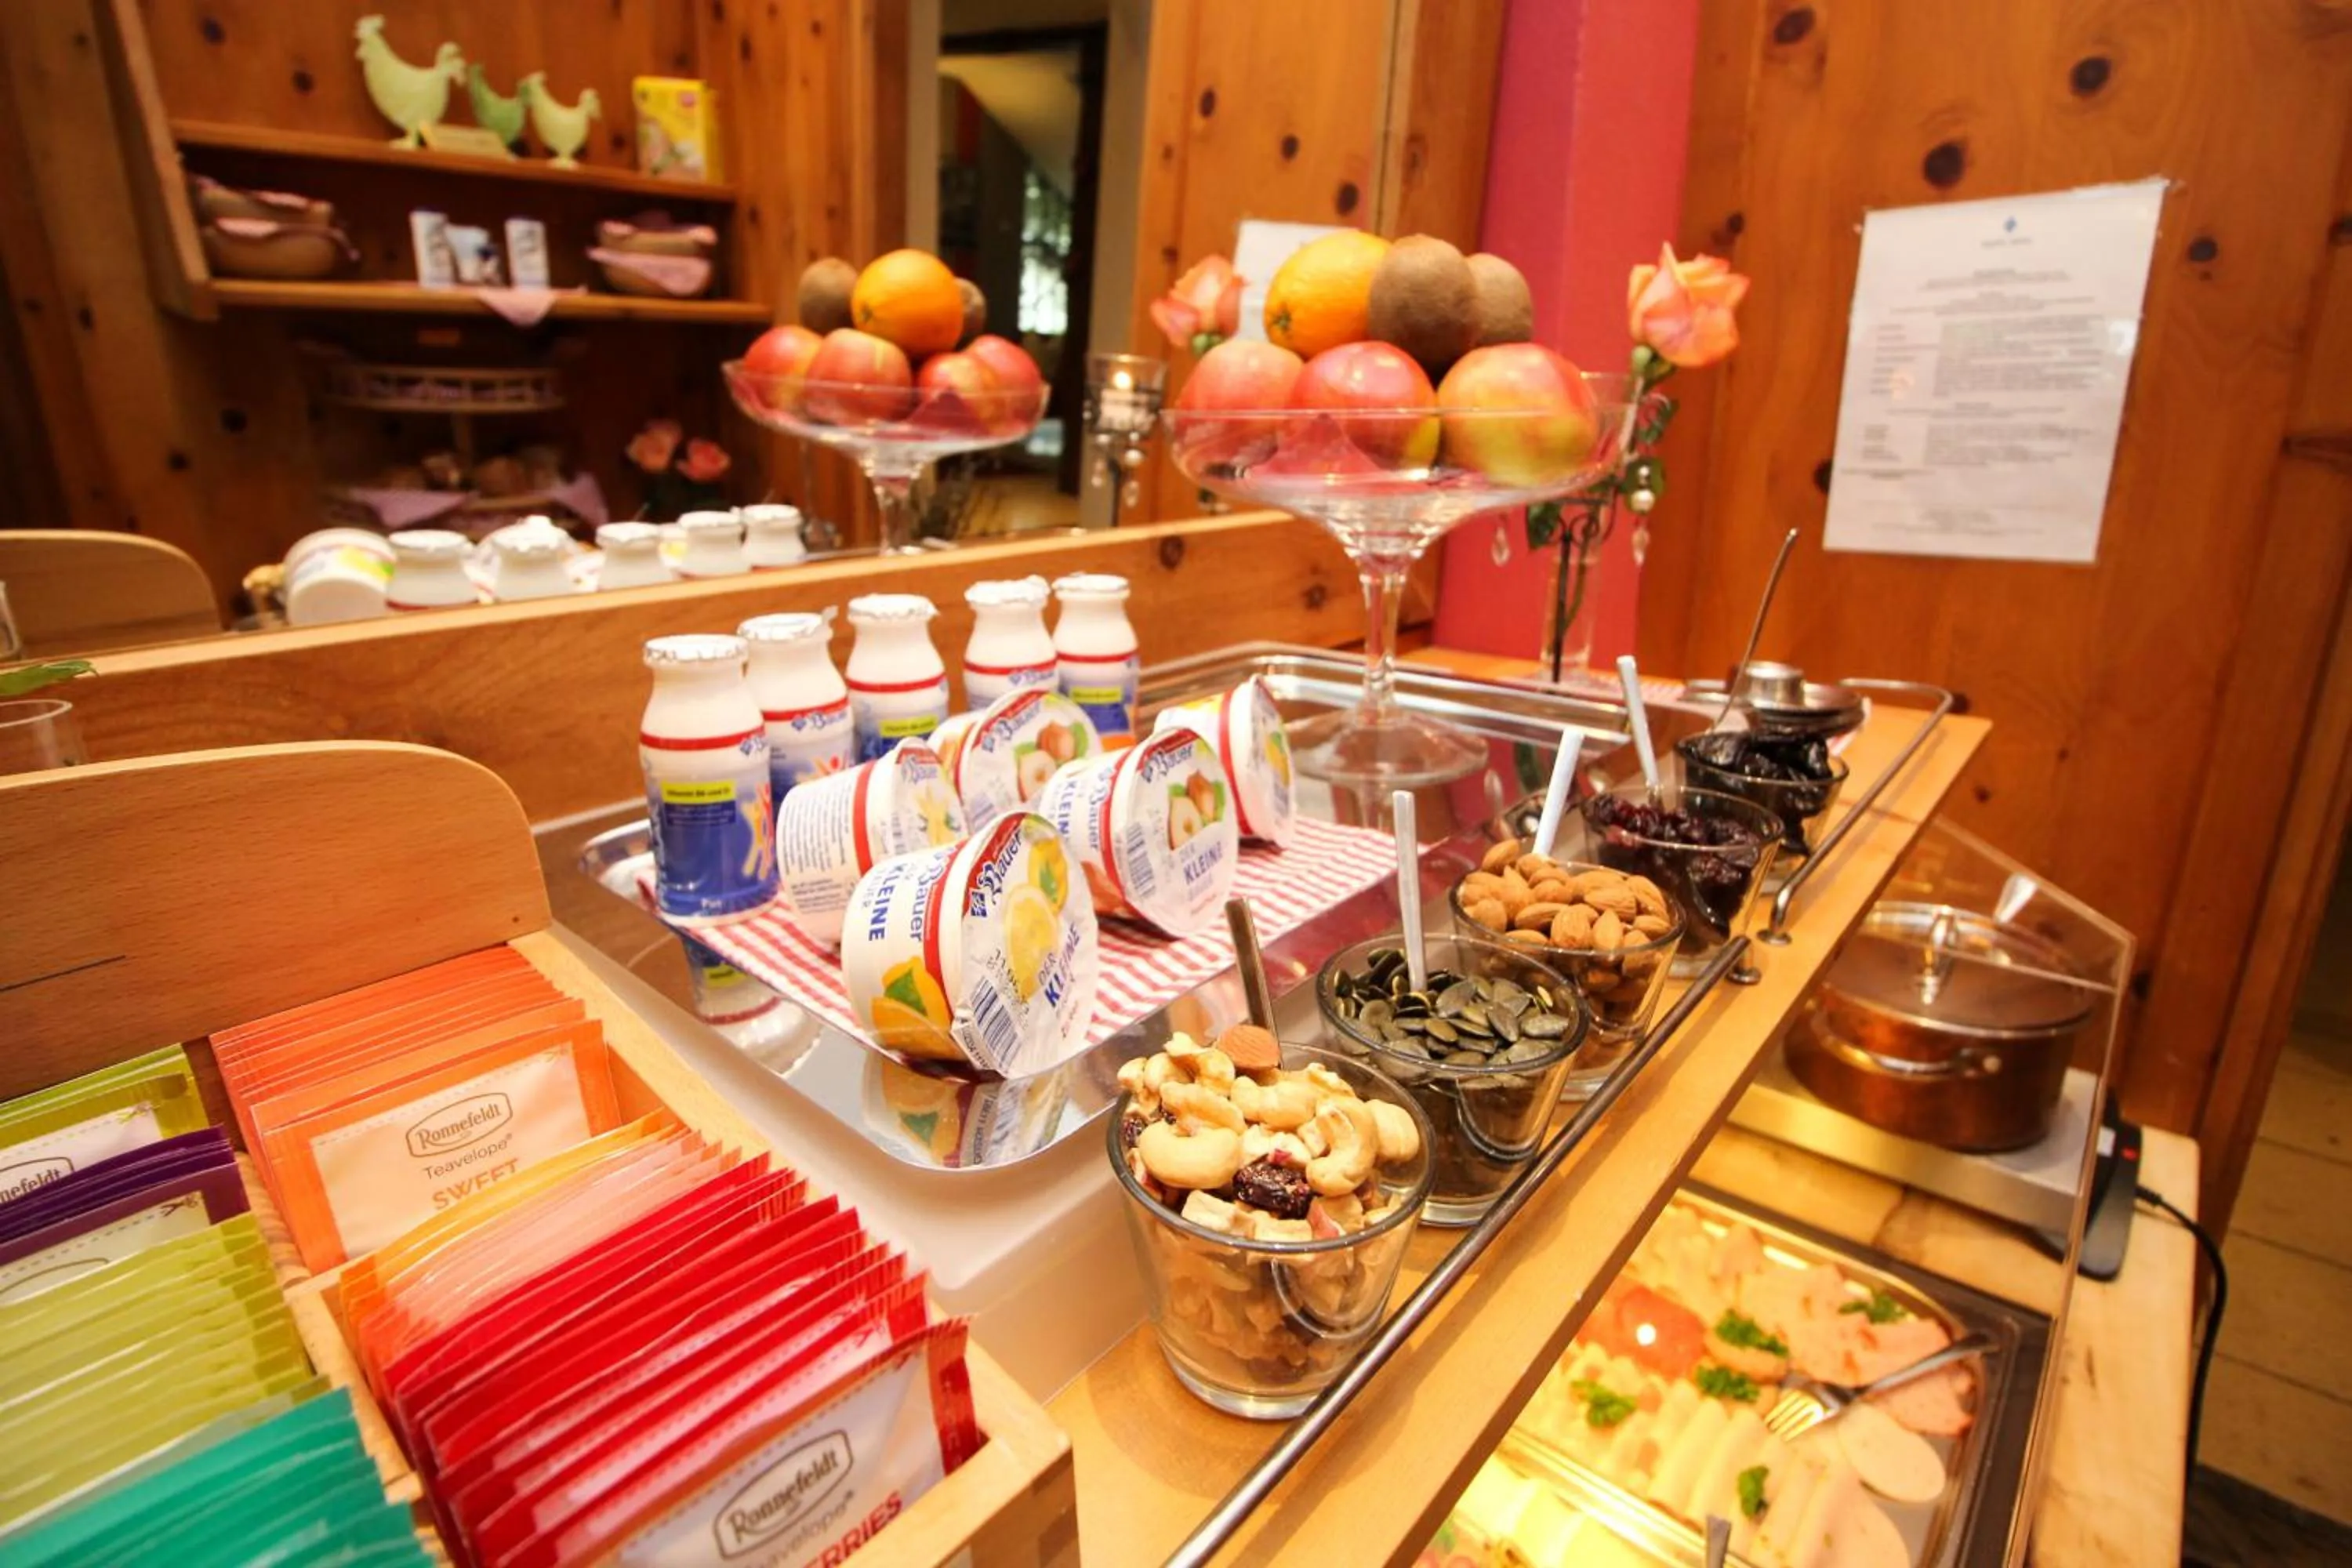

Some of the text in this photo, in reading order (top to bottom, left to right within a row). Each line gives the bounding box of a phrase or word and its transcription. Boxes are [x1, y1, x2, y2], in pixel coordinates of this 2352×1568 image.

[1152, 744, 1192, 781] Bauer
[1058, 781, 1077, 840] KLEIN
[868, 862, 907, 942] KLEINE
[910, 862, 944, 942] Bauer
[978, 828, 1022, 906] Bauer
[1044, 922, 1080, 1008] KLEINE
[414, 1103, 502, 1150] Ronnefeldt
[728, 1449, 839, 1543] Ronnefeldt
